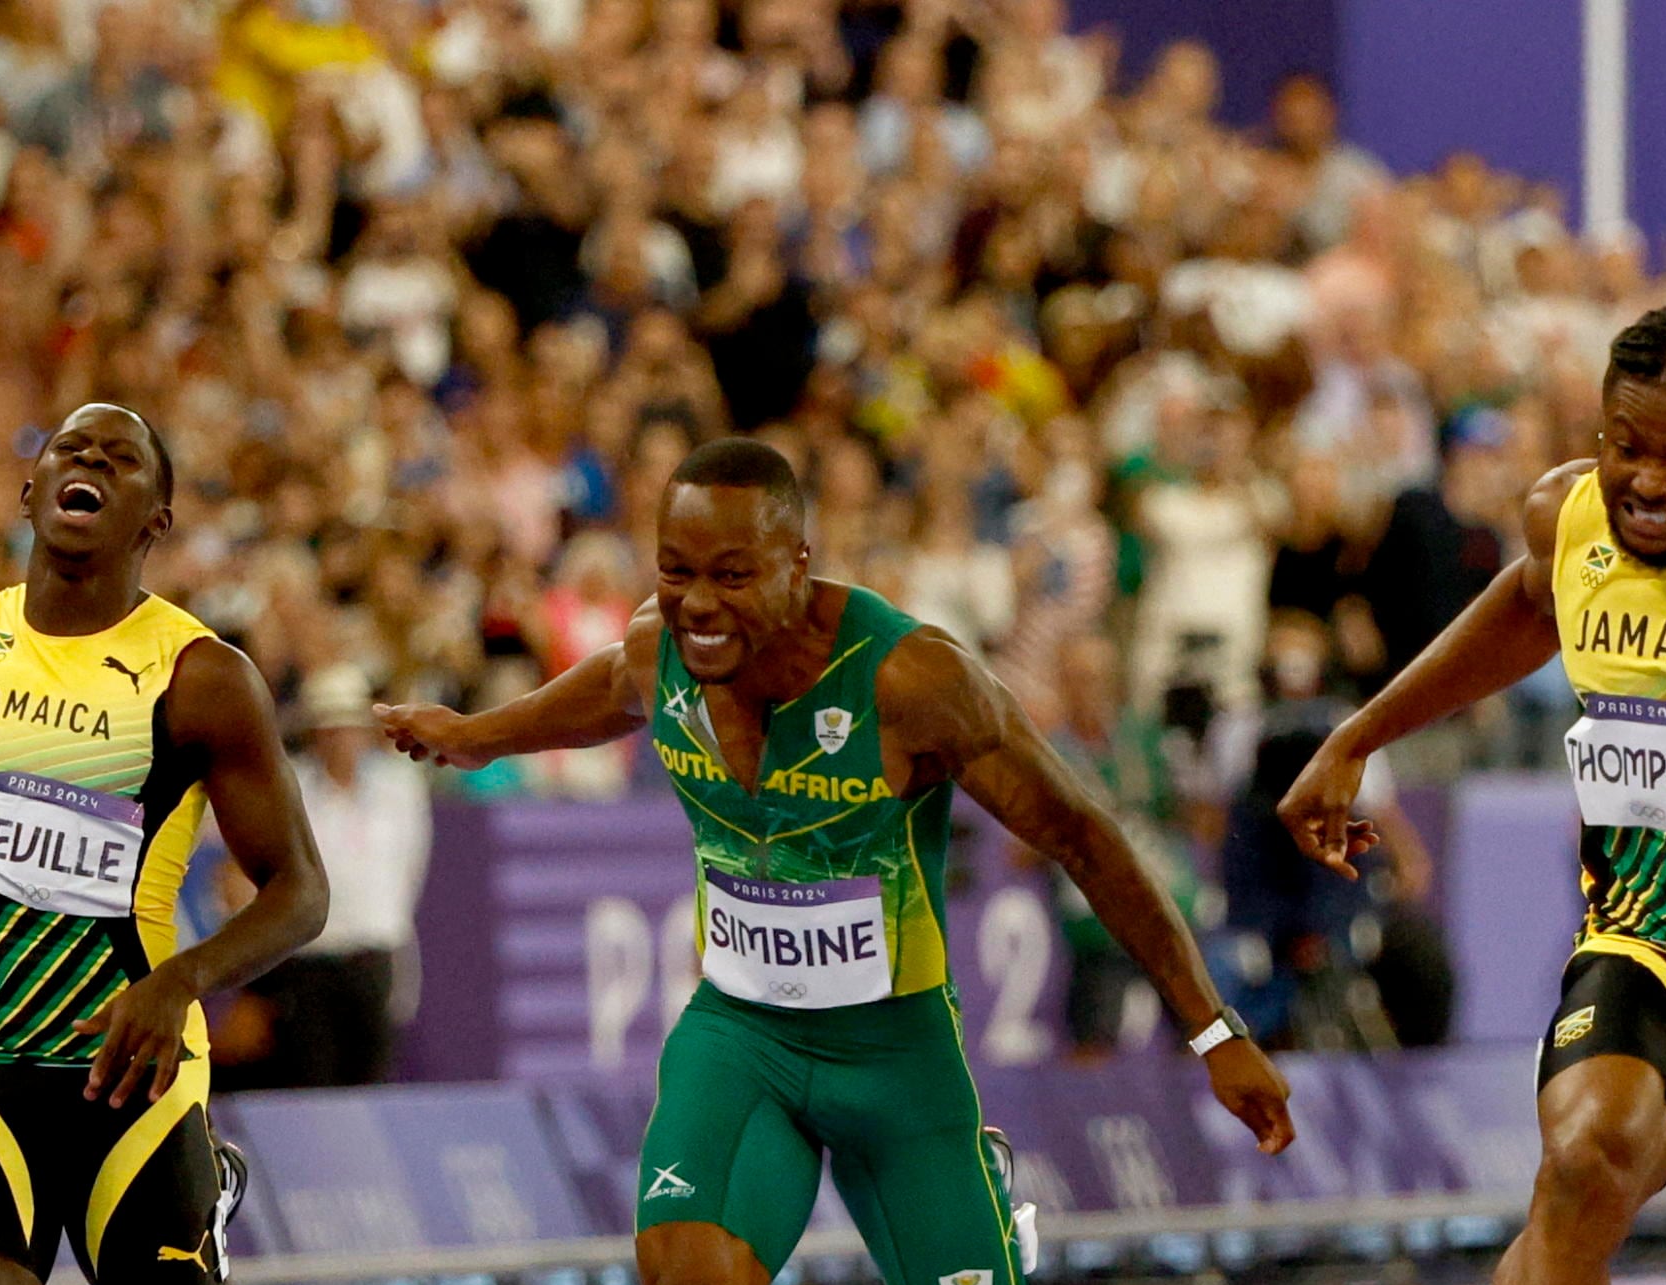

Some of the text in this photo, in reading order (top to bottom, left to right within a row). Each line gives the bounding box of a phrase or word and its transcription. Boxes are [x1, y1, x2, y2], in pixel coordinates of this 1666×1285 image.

[1597, 700, 1644, 717] PARIS
[7, 775, 100, 810] PARIS 2024
[764, 769, 895, 804] AFRICA
[732, 881, 827, 901] PARIS 2024
[709, 906, 878, 968] SIMBINE
